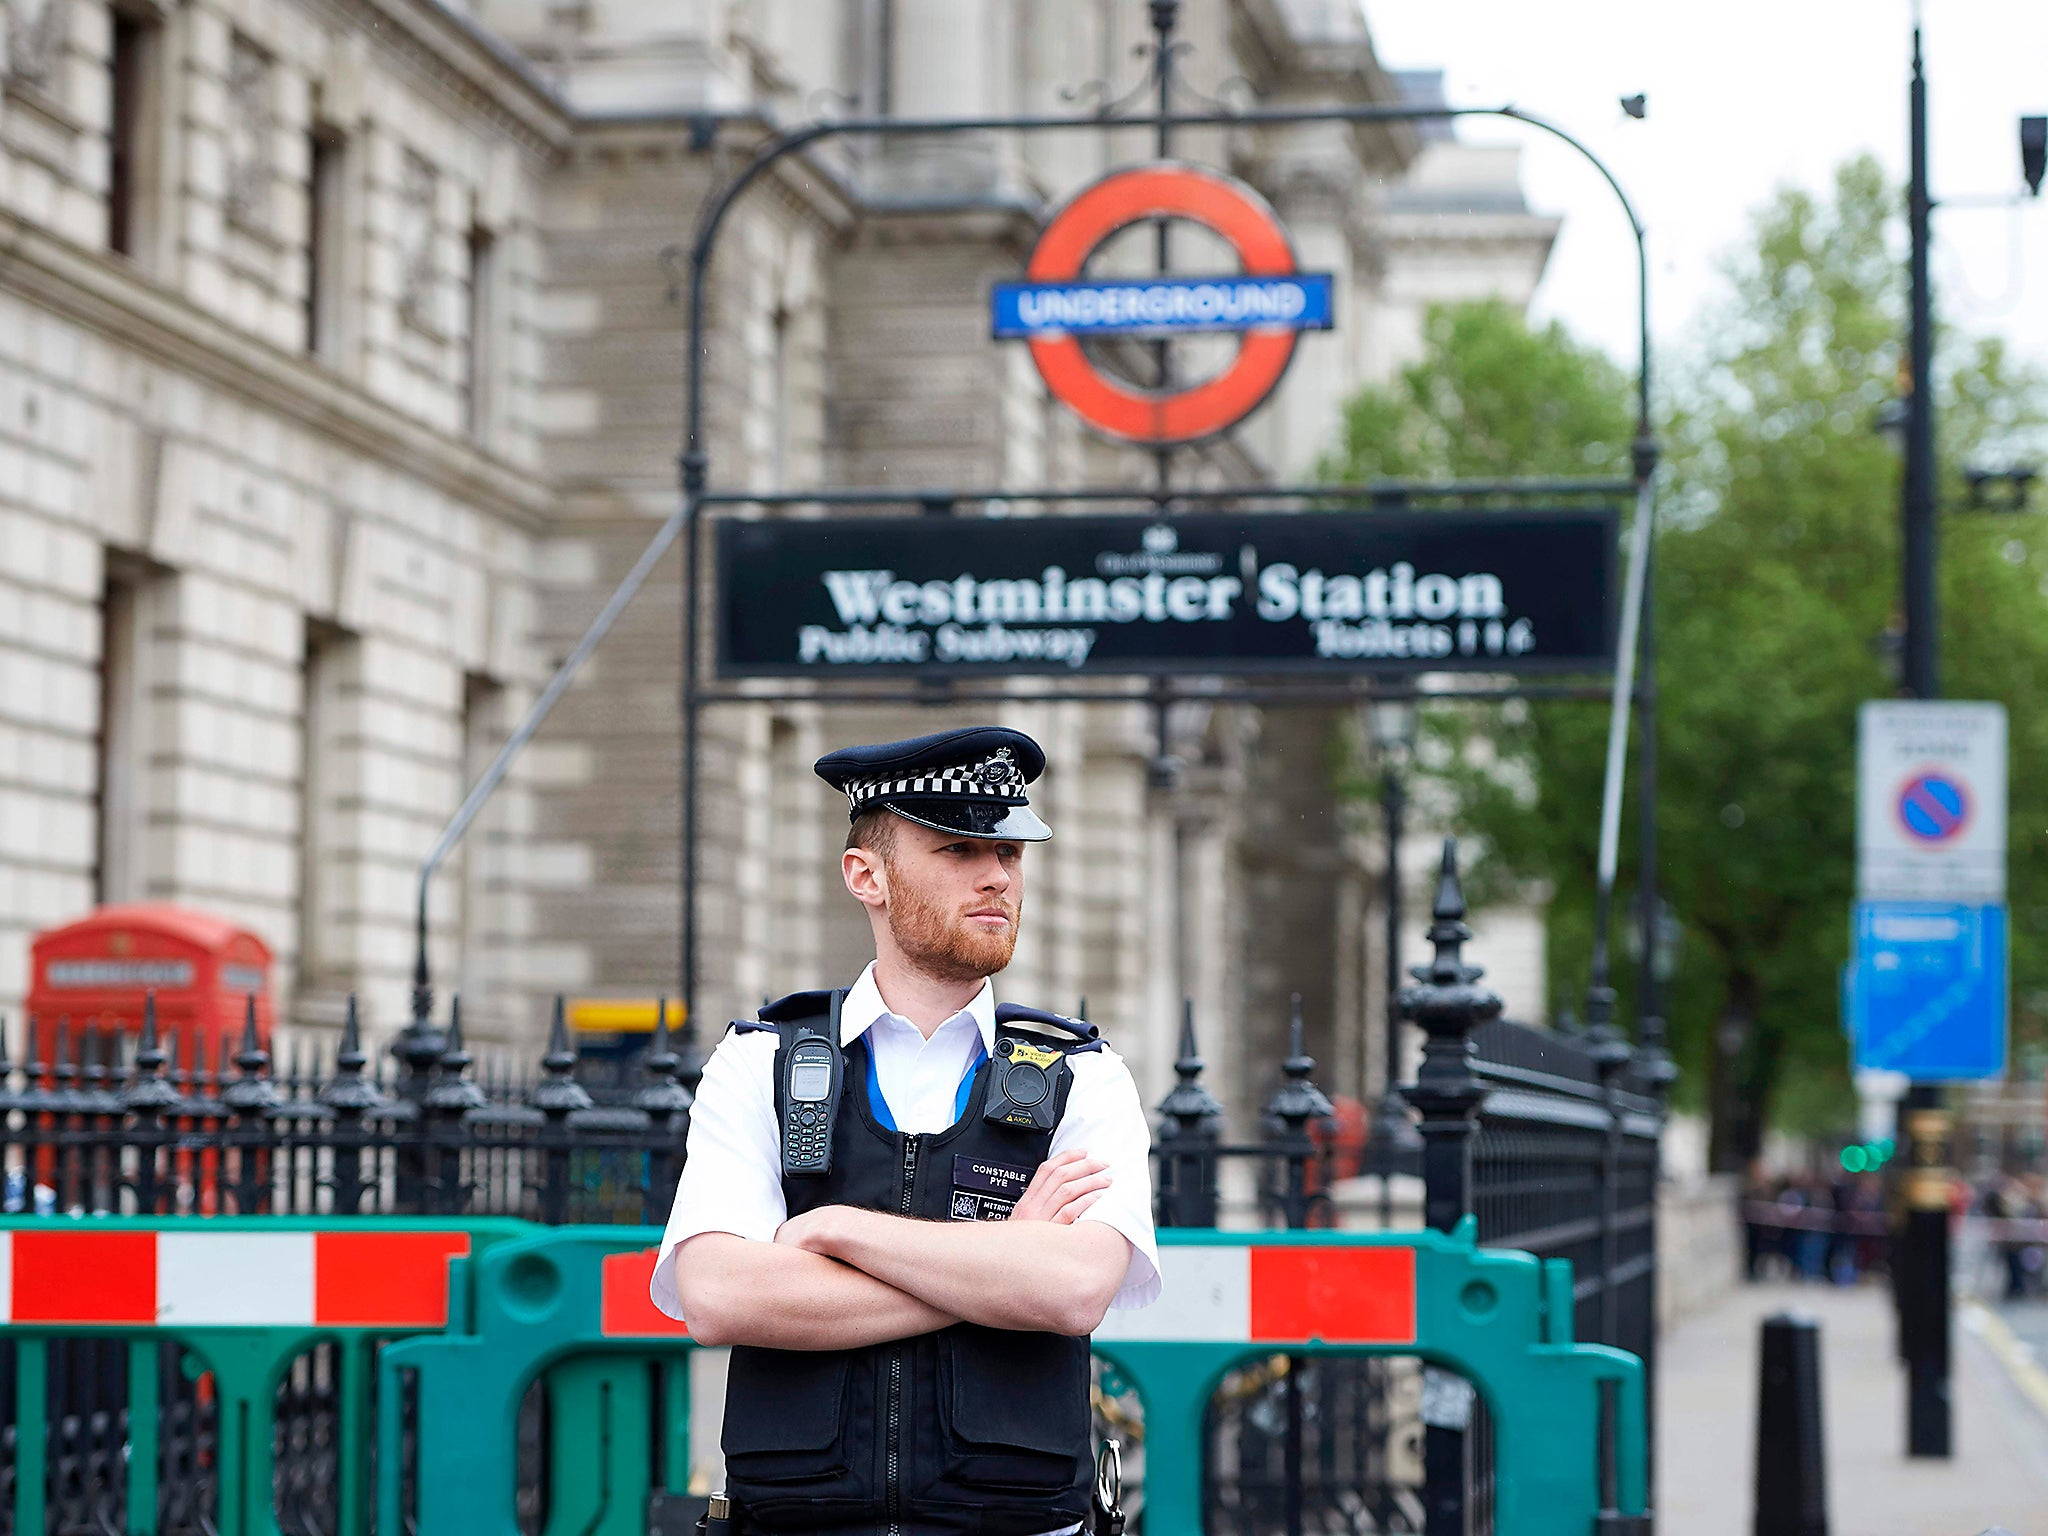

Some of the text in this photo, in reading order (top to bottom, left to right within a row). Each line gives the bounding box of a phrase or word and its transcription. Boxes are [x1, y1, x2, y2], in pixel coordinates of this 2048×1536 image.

[1018, 283, 1306, 327] UNDERGROUND
[821, 561, 1507, 624] Westminster Station
[799, 621, 1097, 668] Public Subway
[1309, 617, 1453, 658] Toilets
[1013, 1115, 1032, 1124] AXON
[972, 1164, 1027, 1182] CONSTABLE
[989, 1176, 1008, 1188] PYE
[983, 1201, 1013, 1213] METROPO
